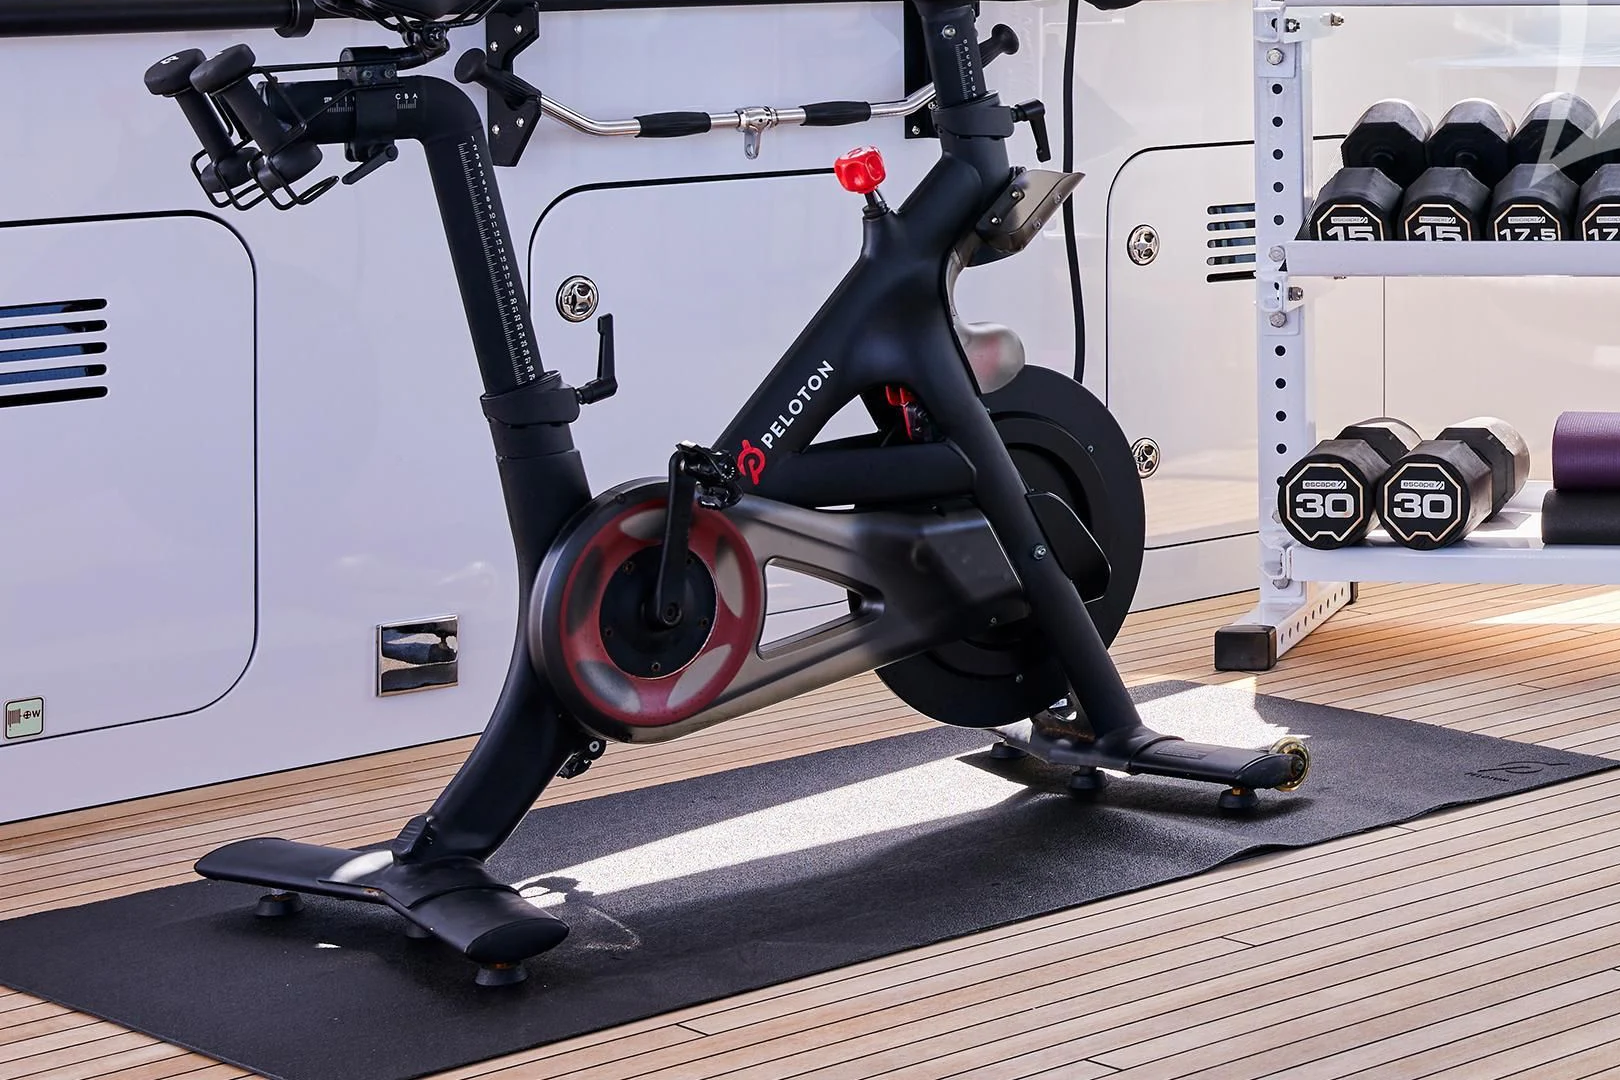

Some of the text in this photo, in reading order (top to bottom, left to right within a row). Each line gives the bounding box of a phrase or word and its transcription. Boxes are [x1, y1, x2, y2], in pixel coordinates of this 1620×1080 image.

[1326, 226, 1374, 241] 15
[1413, 226, 1463, 241] 15
[1499, 228, 1557, 241] 17.5
[504, 272, 510, 280] 17
[760, 360, 834, 450] PELOTON
[1304, 481, 1337, 489] escape
[1403, 481, 1435, 489] escape
[1295, 493, 1355, 518] 30
[1393, 492, 1452, 519] 30
[32, 709, 41, 718] W
